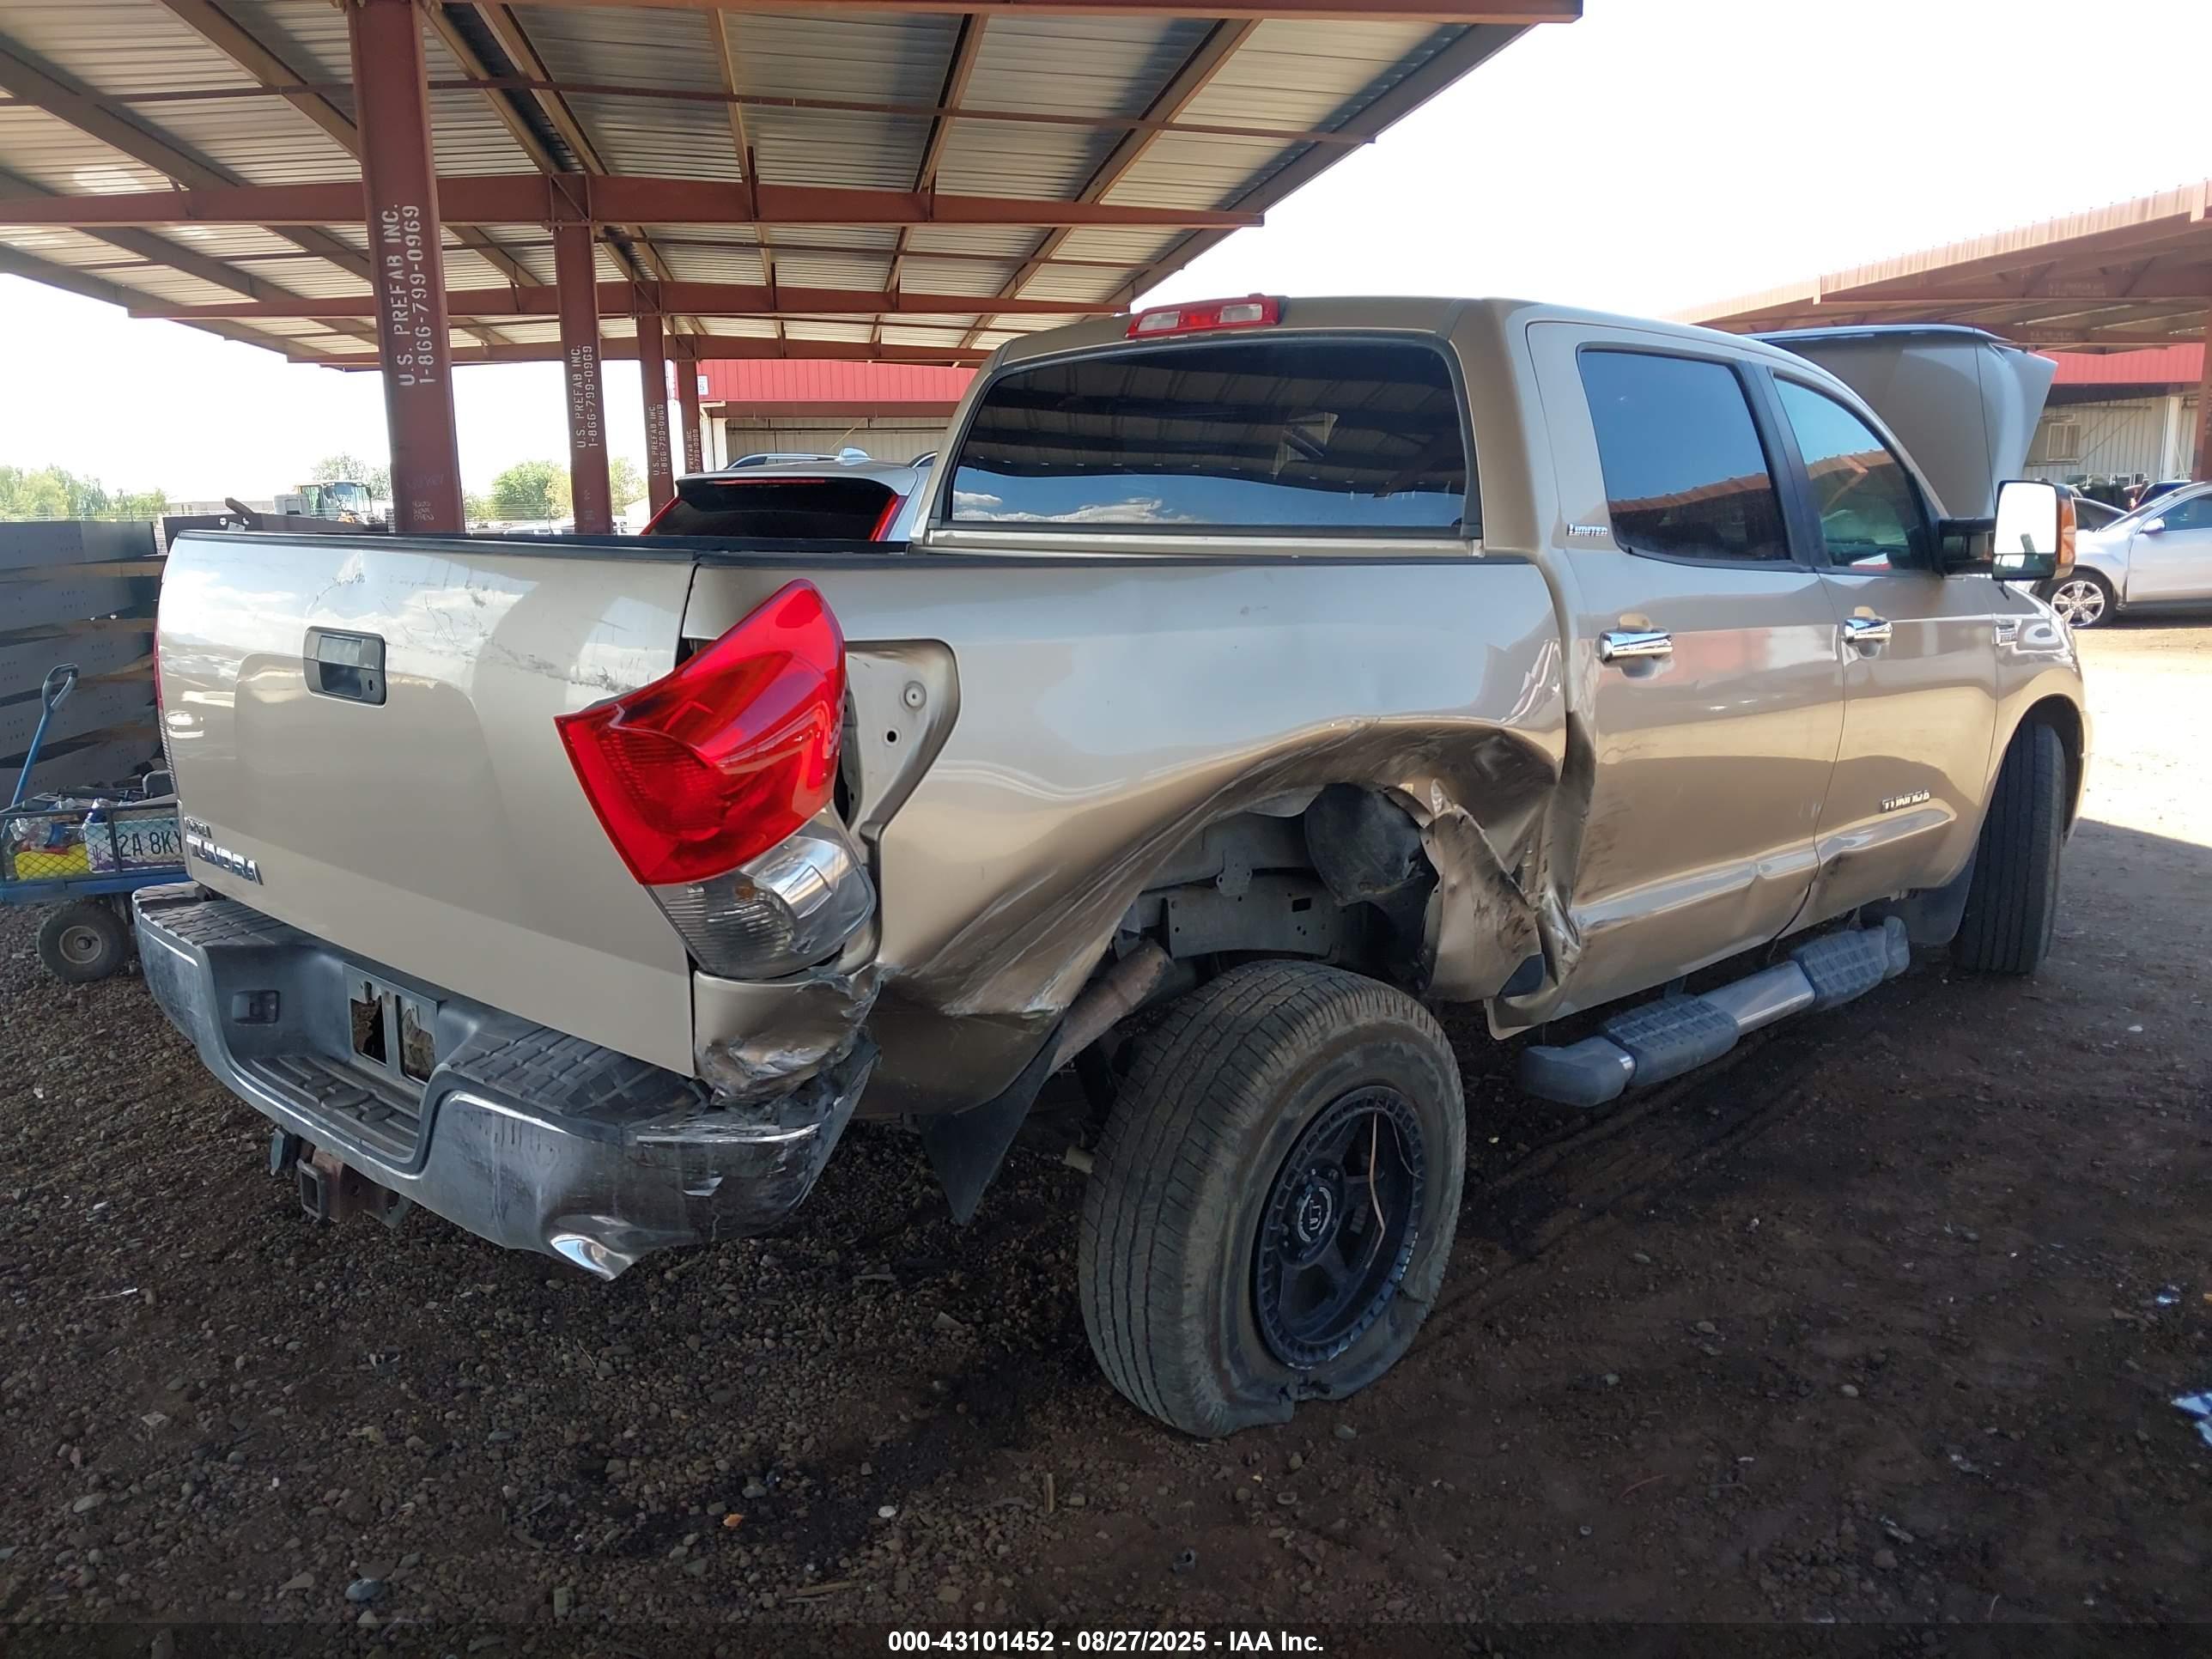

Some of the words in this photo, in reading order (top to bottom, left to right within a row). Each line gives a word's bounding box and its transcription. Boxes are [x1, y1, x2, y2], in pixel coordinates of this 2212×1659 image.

[381, 204, 402, 243] INC.
[386, 254, 411, 336] PREFAB
[402, 205, 436, 385] 1-866-799-0969
[397, 348, 416, 386] U.S.
[570, 344, 580, 368] INC.
[572, 373, 586, 420] PREFAB
[582, 345, 599, 447] 1-866-799-0969
[576, 425, 586, 448] U.S.
[185, 834, 264, 886] TUNDRA
